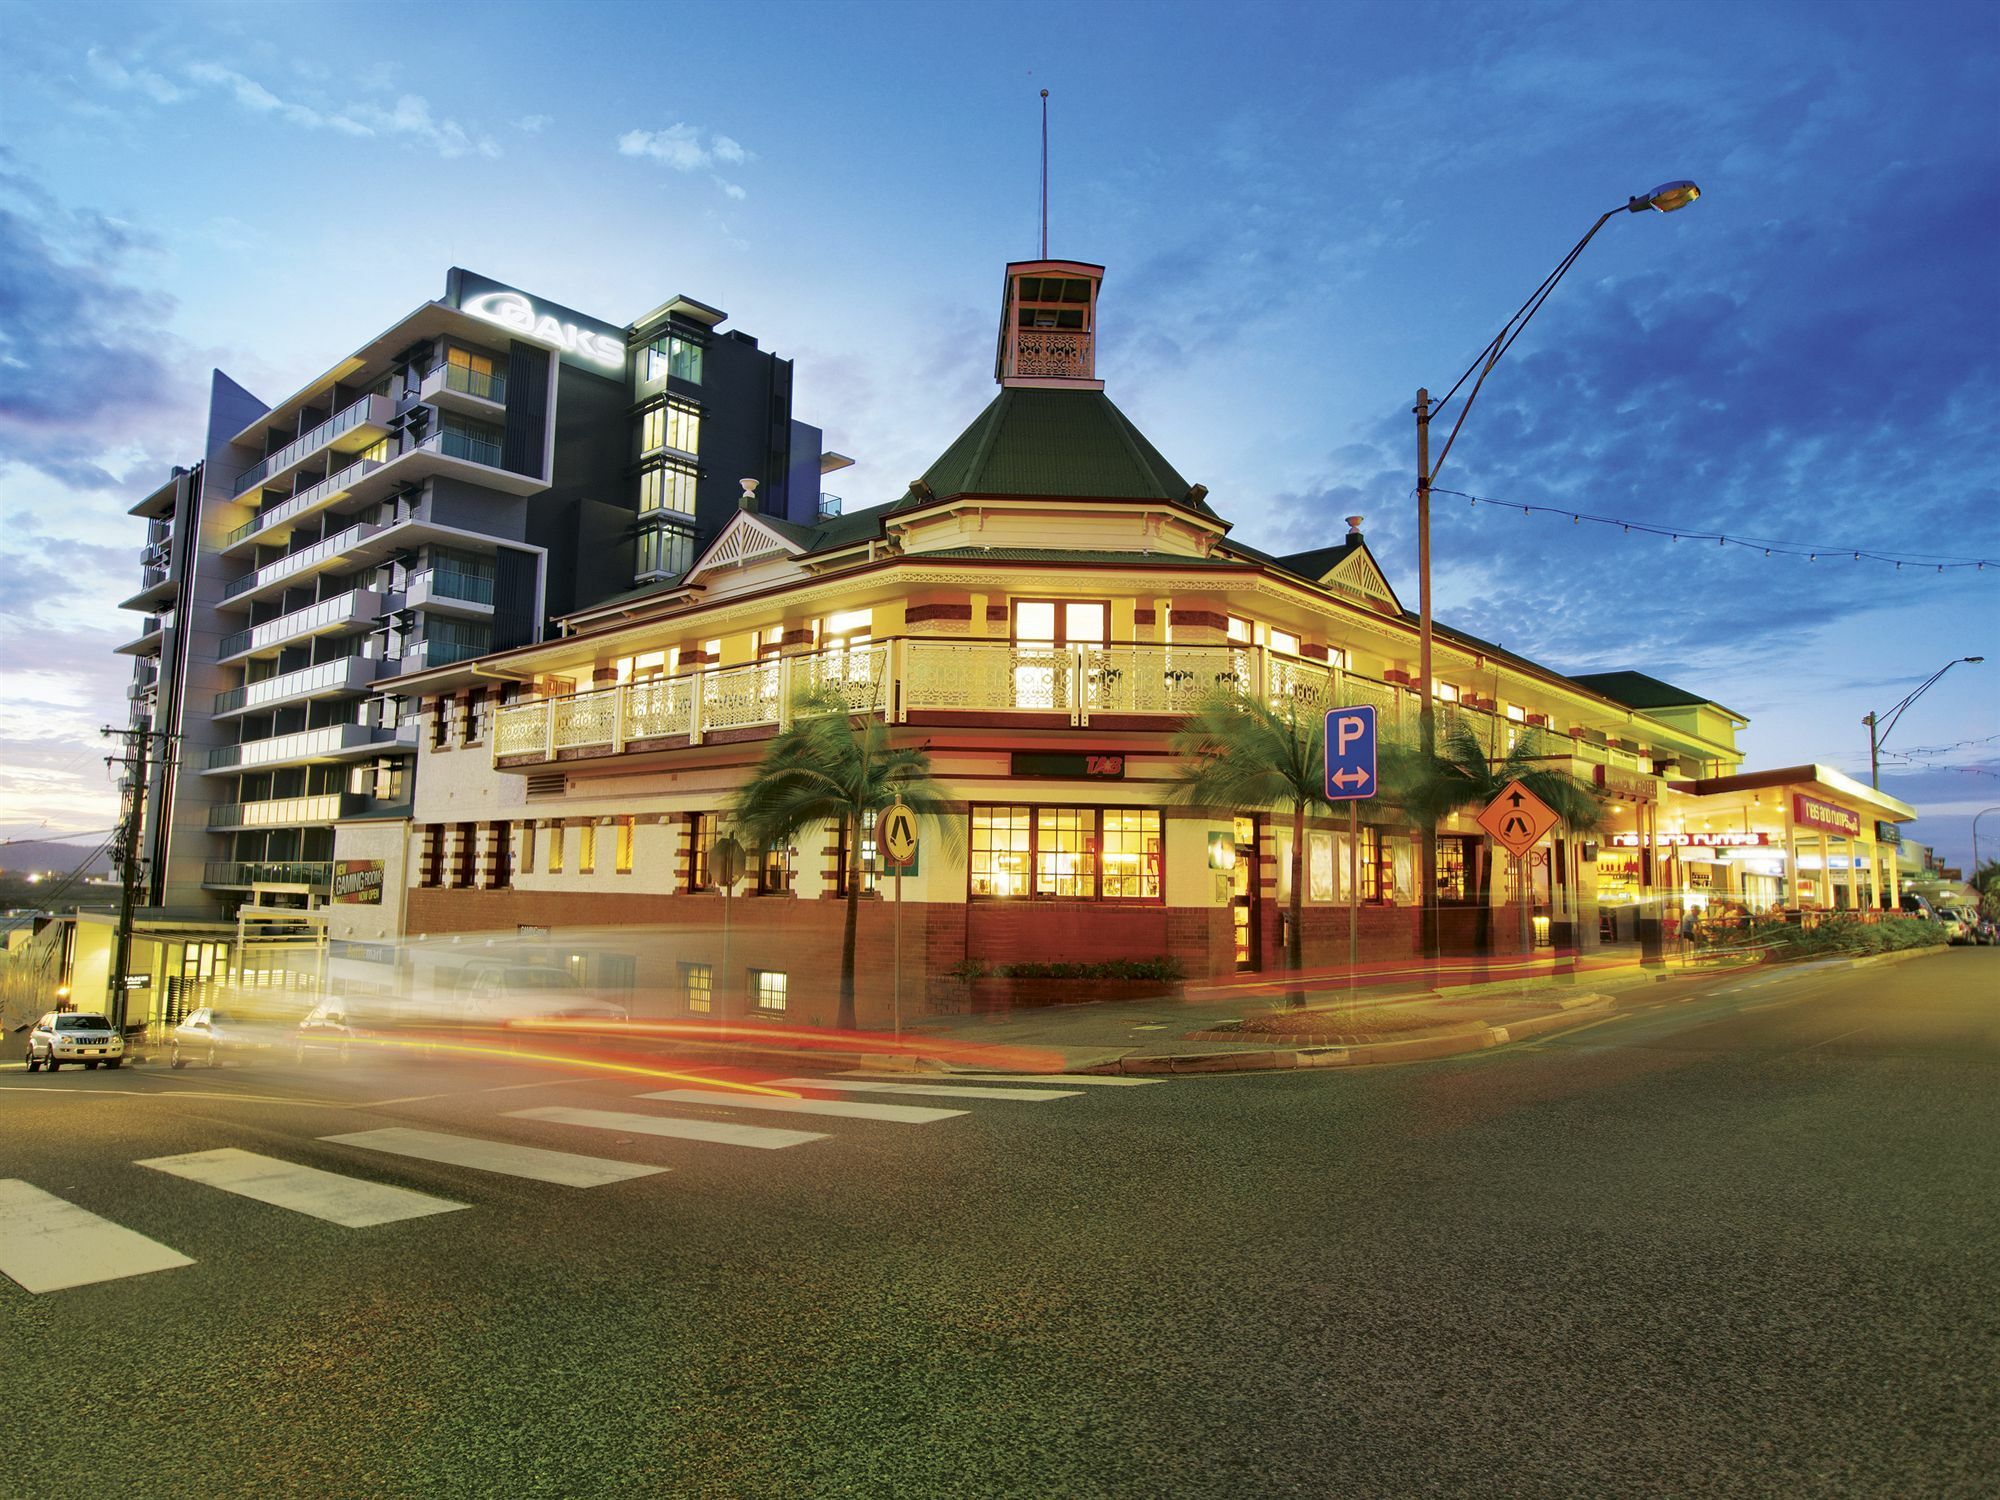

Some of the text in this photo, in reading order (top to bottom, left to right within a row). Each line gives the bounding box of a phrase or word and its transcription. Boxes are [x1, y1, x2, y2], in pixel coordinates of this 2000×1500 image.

[461, 292, 626, 365] OAKS
[1338, 716, 1365, 756] P
[1086, 756, 1122, 774] TAB
[1636, 779, 1657, 796] HOTEL
[335, 871, 364, 896] GAMING
[368, 888, 380, 900] OPEN
